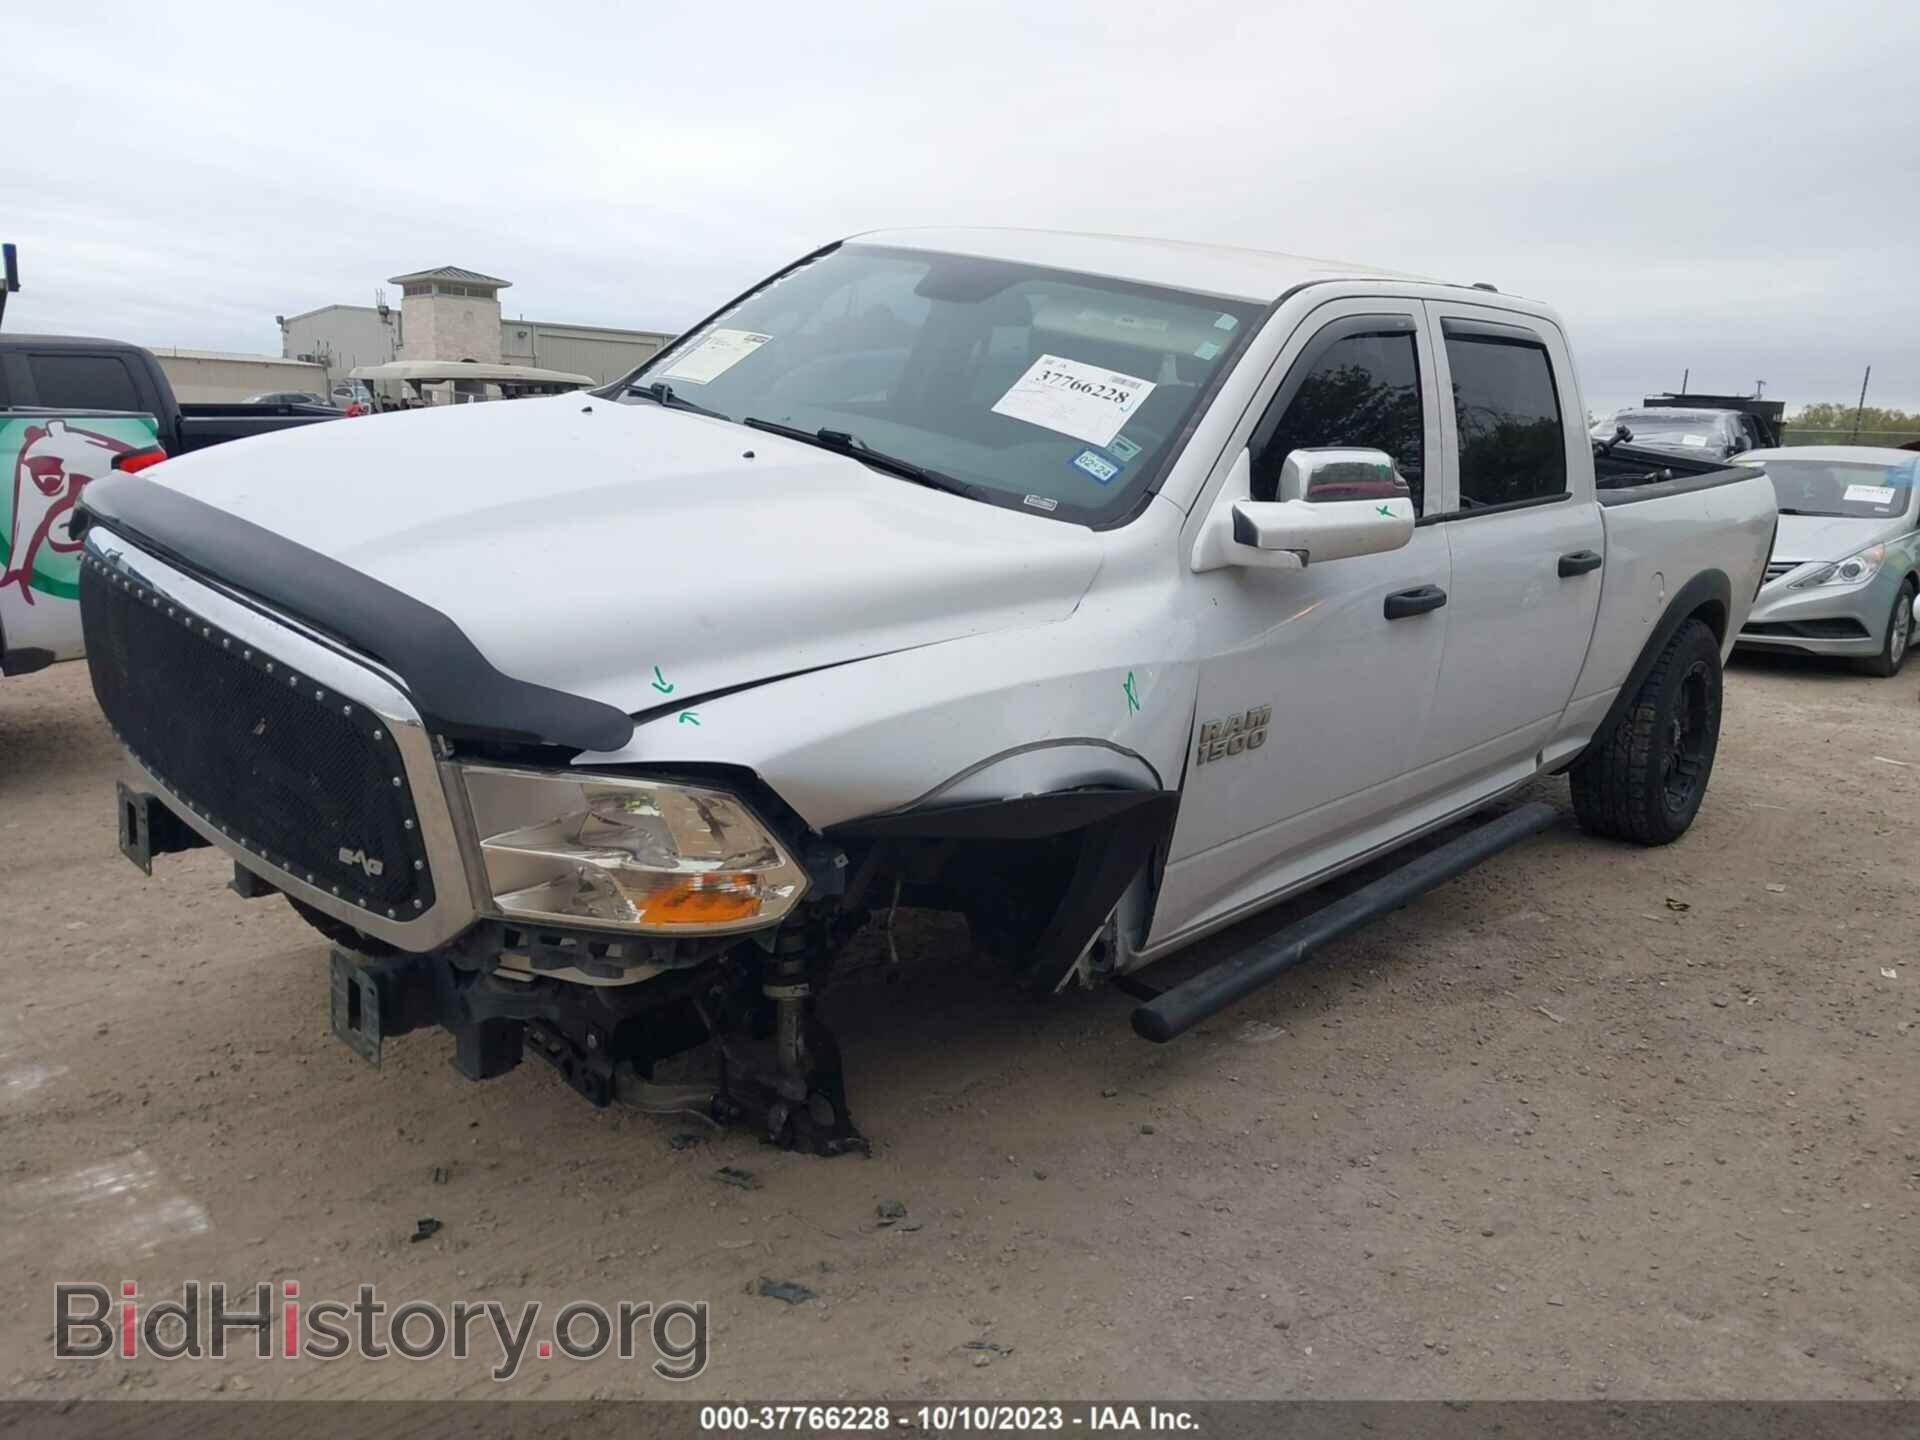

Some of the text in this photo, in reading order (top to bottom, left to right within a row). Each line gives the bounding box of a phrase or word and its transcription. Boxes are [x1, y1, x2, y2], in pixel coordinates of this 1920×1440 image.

[1035, 370, 1130, 404] 37766228
[1199, 704, 1272, 744] RAM
[1196, 725, 1267, 766] 1500
